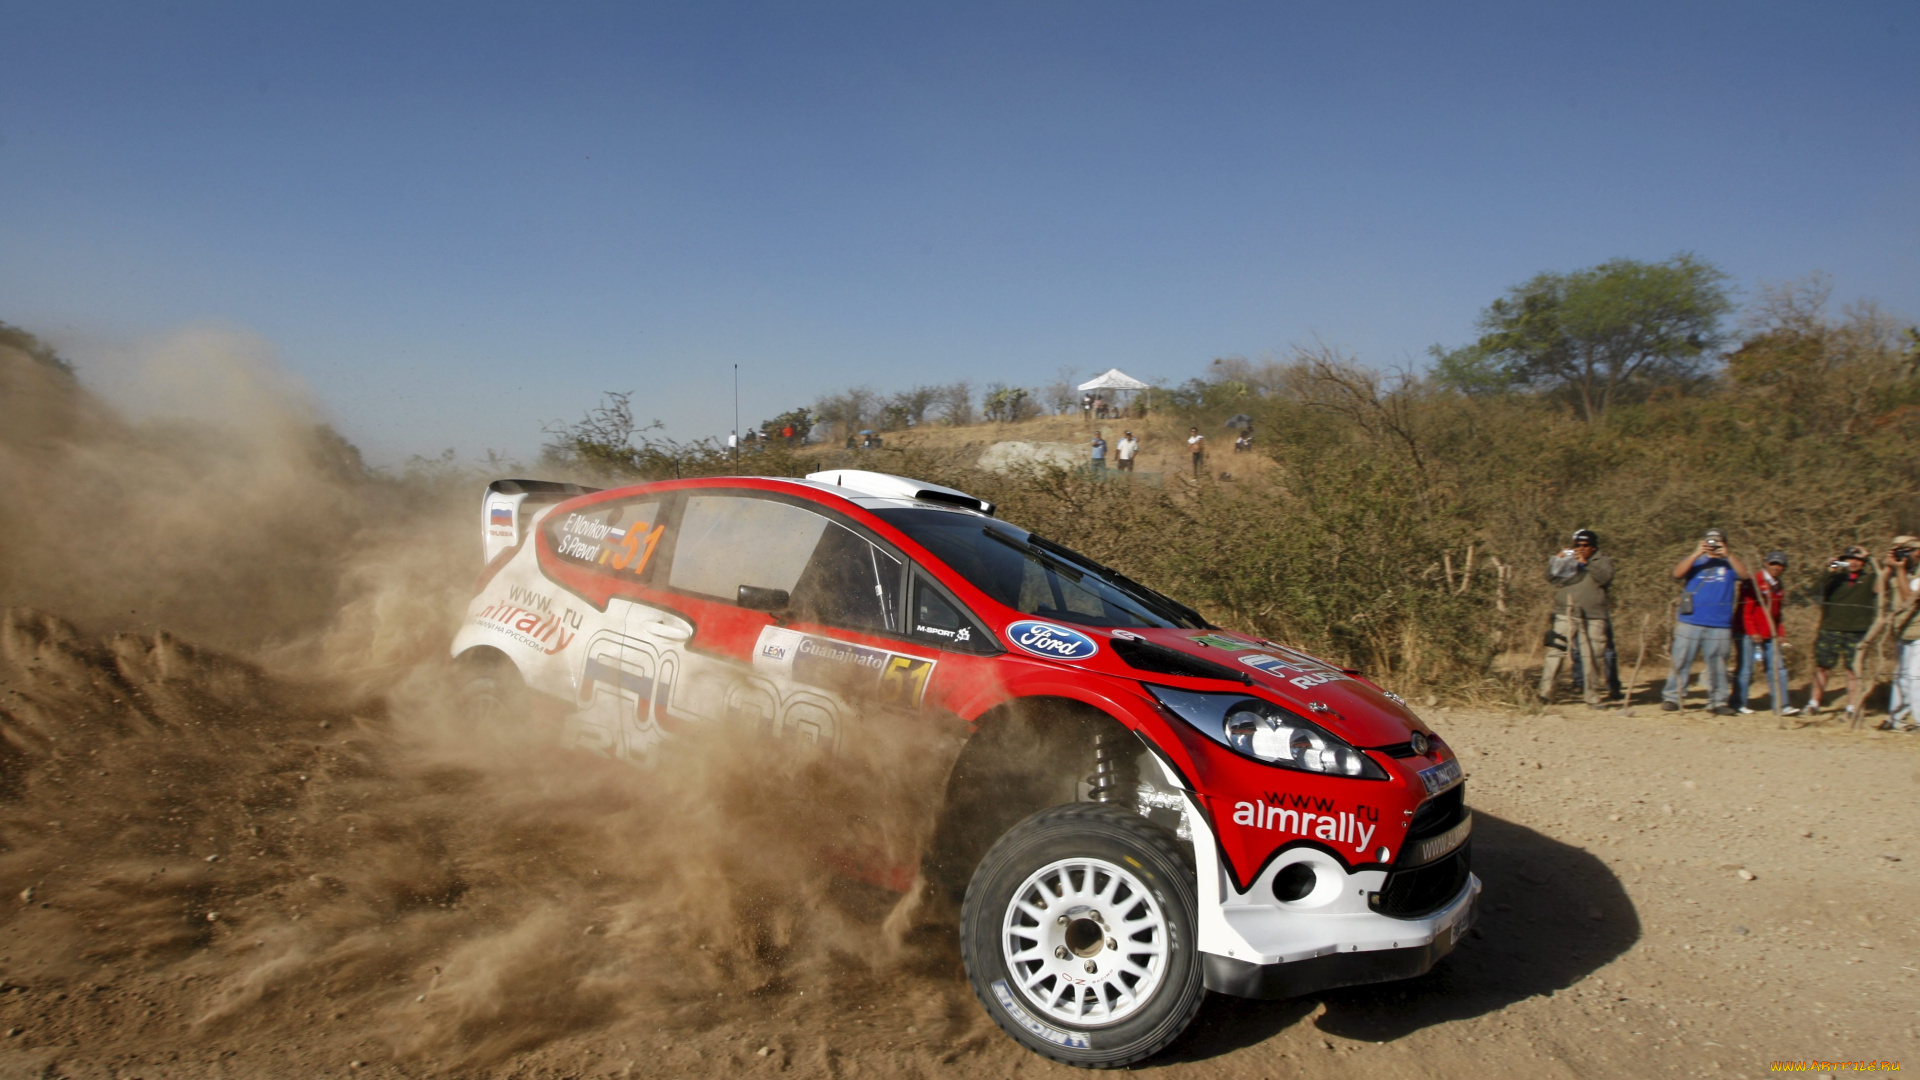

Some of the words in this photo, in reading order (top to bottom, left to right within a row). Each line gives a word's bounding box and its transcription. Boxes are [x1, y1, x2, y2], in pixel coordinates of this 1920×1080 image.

[562, 513, 577, 532] E
[571, 514, 611, 541] Novikov
[558, 535, 569, 553] S
[566, 537, 601, 561] Prevot
[613, 521, 665, 575] 51
[562, 607, 584, 630] ru
[916, 624, 956, 638] M-SPORT
[504, 629, 545, 653] РУССКОМ
[799, 638, 884, 669] Guanajuato
[1020, 624, 1083, 656] Ford
[882, 656, 934, 711] 51
[1232, 799, 1376, 853] almrally
[1356, 804, 1379, 823] ru
